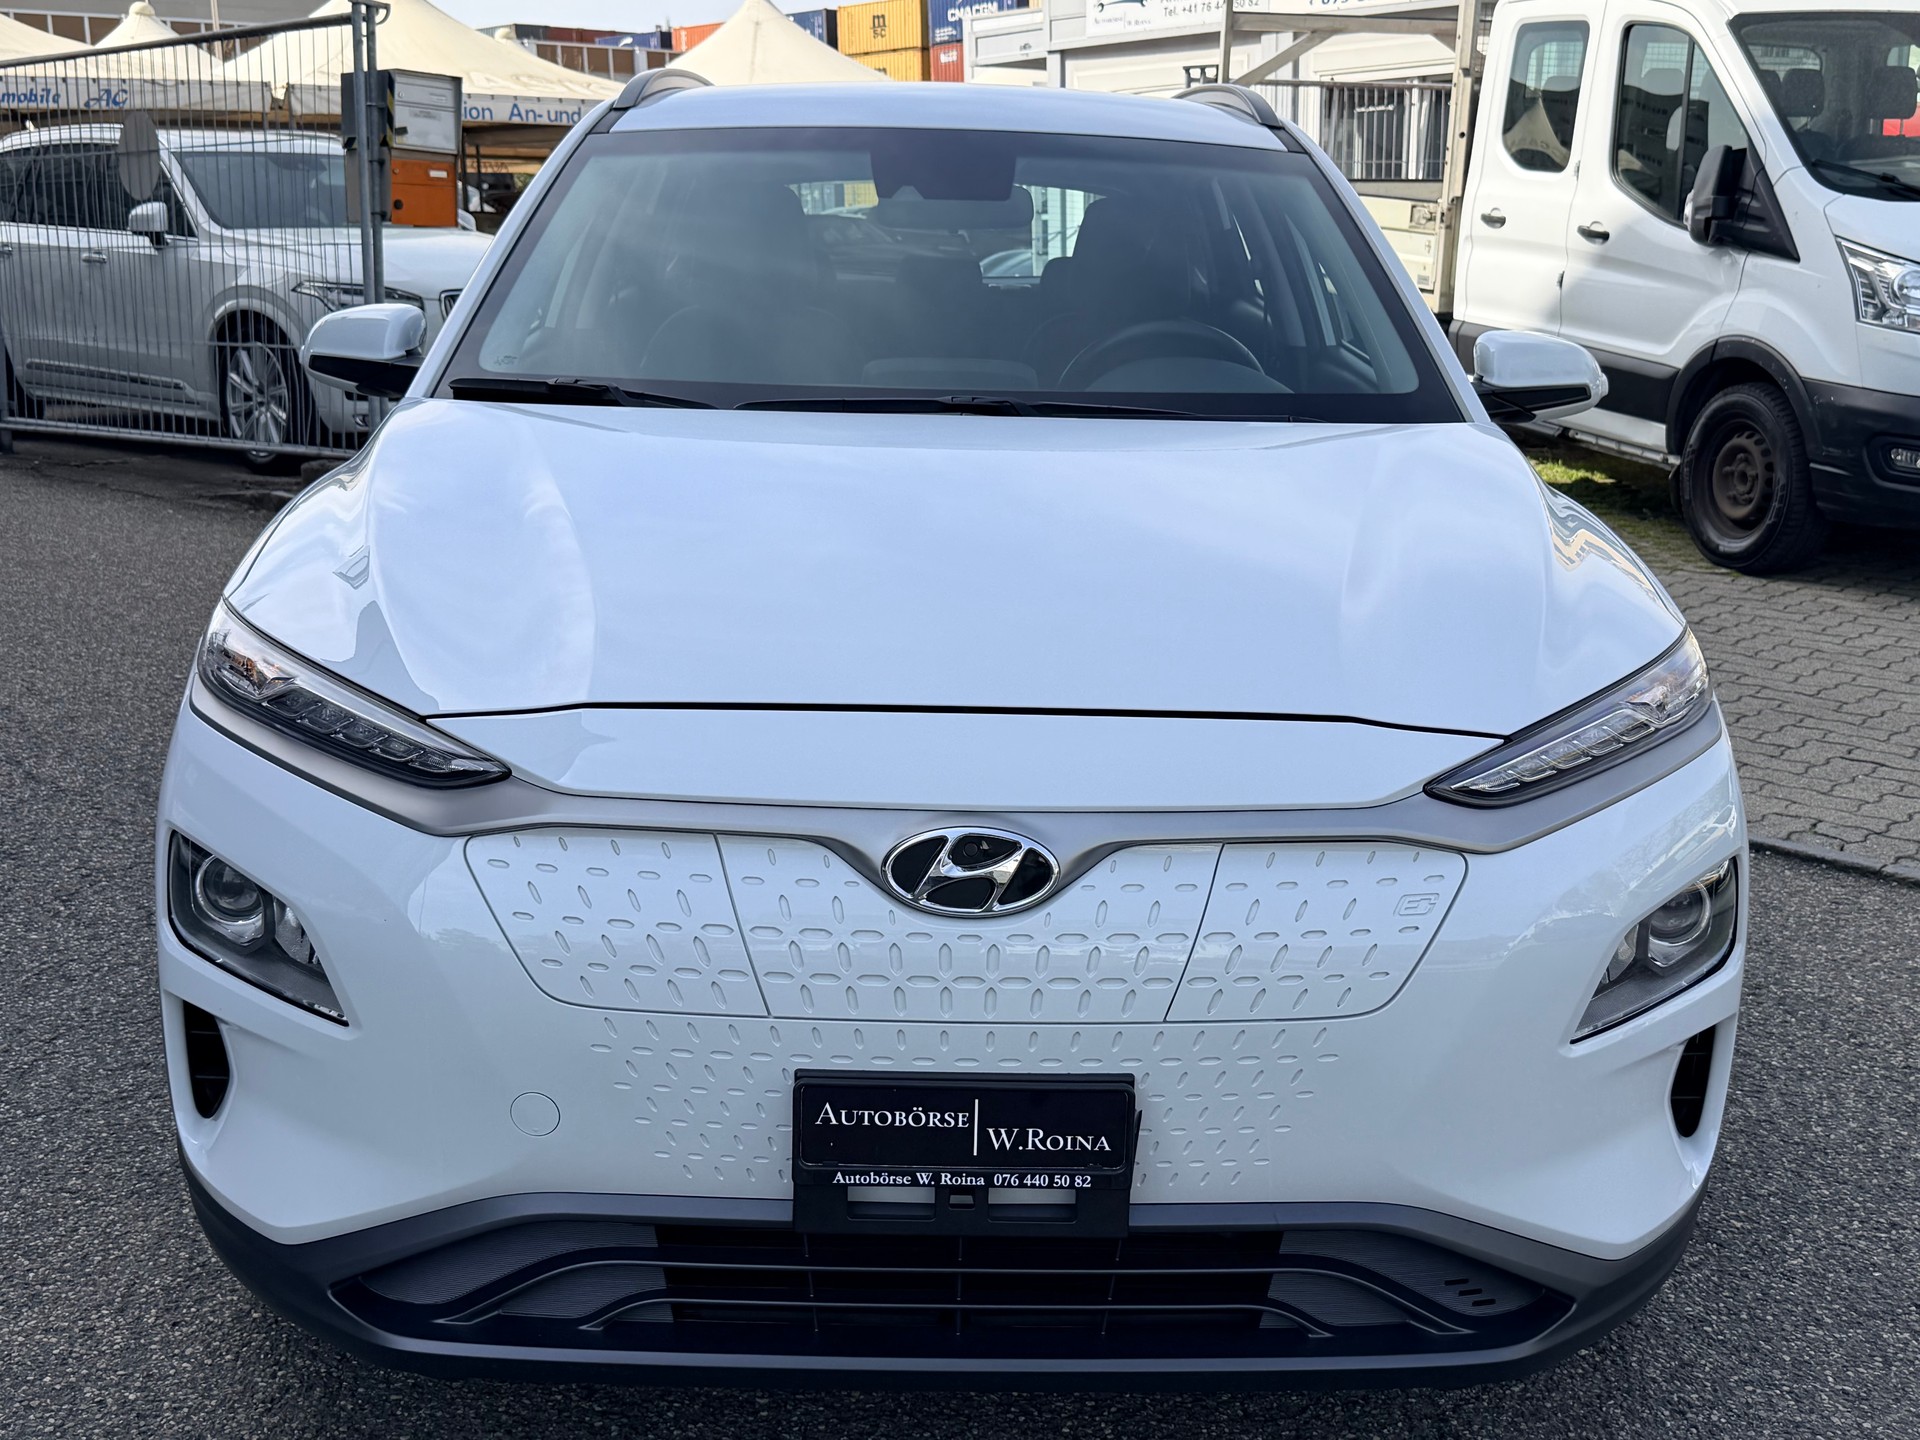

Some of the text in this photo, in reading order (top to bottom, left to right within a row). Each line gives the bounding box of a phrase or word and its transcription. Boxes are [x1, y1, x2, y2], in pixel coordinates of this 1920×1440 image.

[1202, 2, 1212, 12] 76
[814, 1102, 969, 1128] AUTOBÖRSE
[832, 1171, 1092, 1188] Autobörse W. Roina 076 440 50 82
